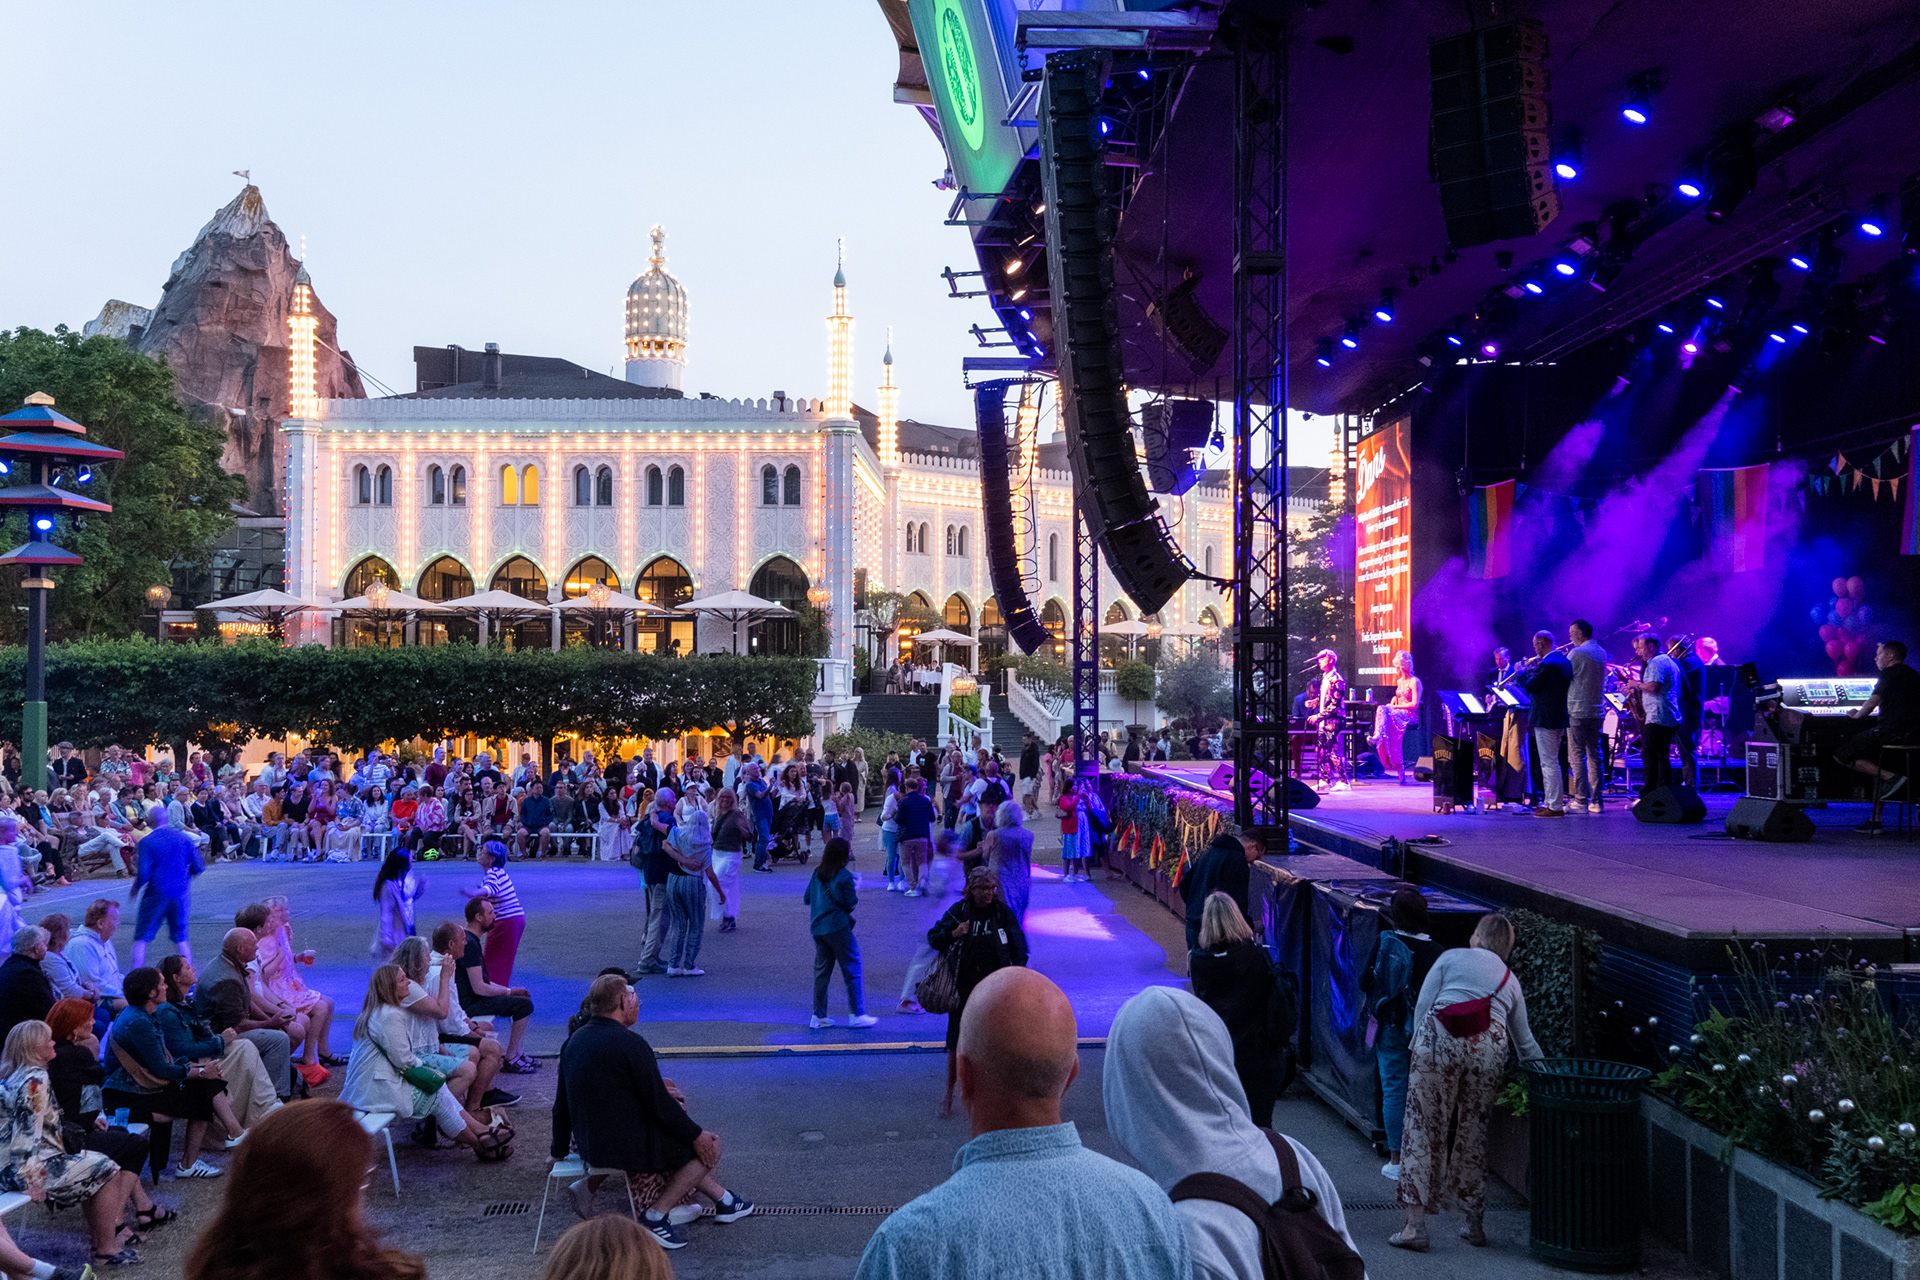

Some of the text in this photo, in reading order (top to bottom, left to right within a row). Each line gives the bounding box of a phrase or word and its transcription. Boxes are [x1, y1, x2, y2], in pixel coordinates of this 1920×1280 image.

[1356, 446, 1386, 504] Dans
[1434, 749, 1452, 760] TIVOLI
[1478, 747, 1495, 759] TIVOLI
